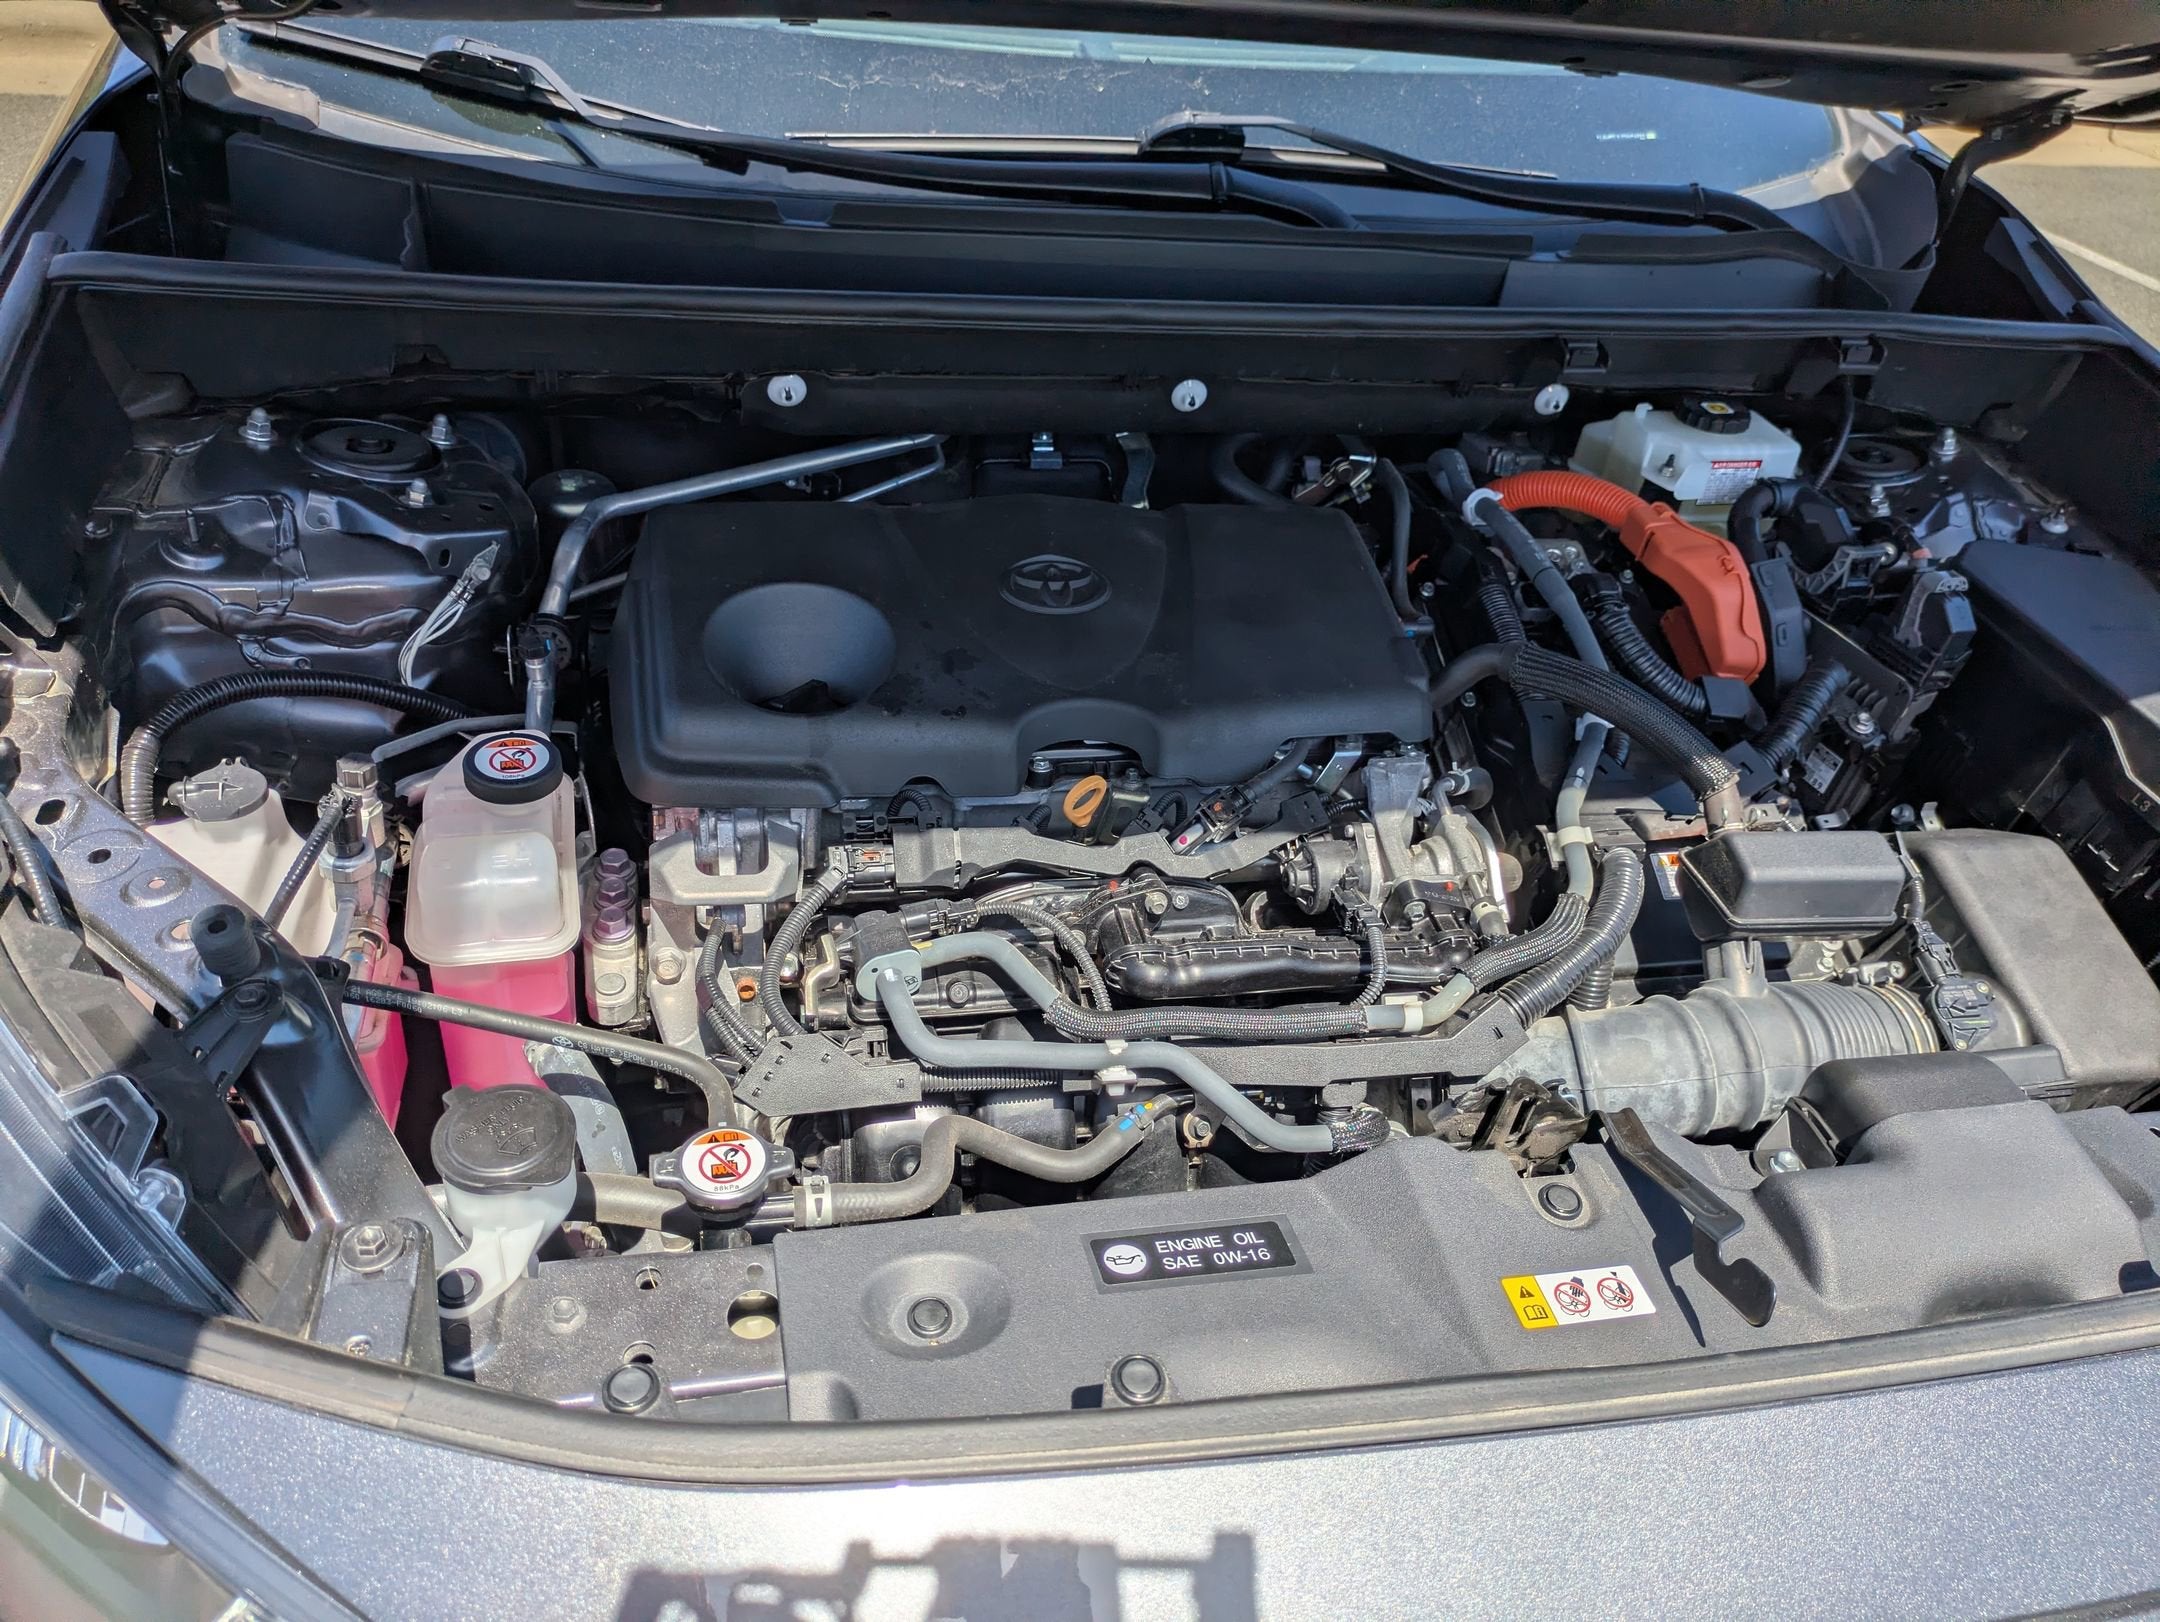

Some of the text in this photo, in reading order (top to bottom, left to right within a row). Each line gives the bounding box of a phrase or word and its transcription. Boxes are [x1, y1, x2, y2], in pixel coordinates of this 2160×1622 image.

[1154, 1231, 1265, 1254] ENGINE OIL
[1162, 1248, 1271, 1270] SAE 0W-16
